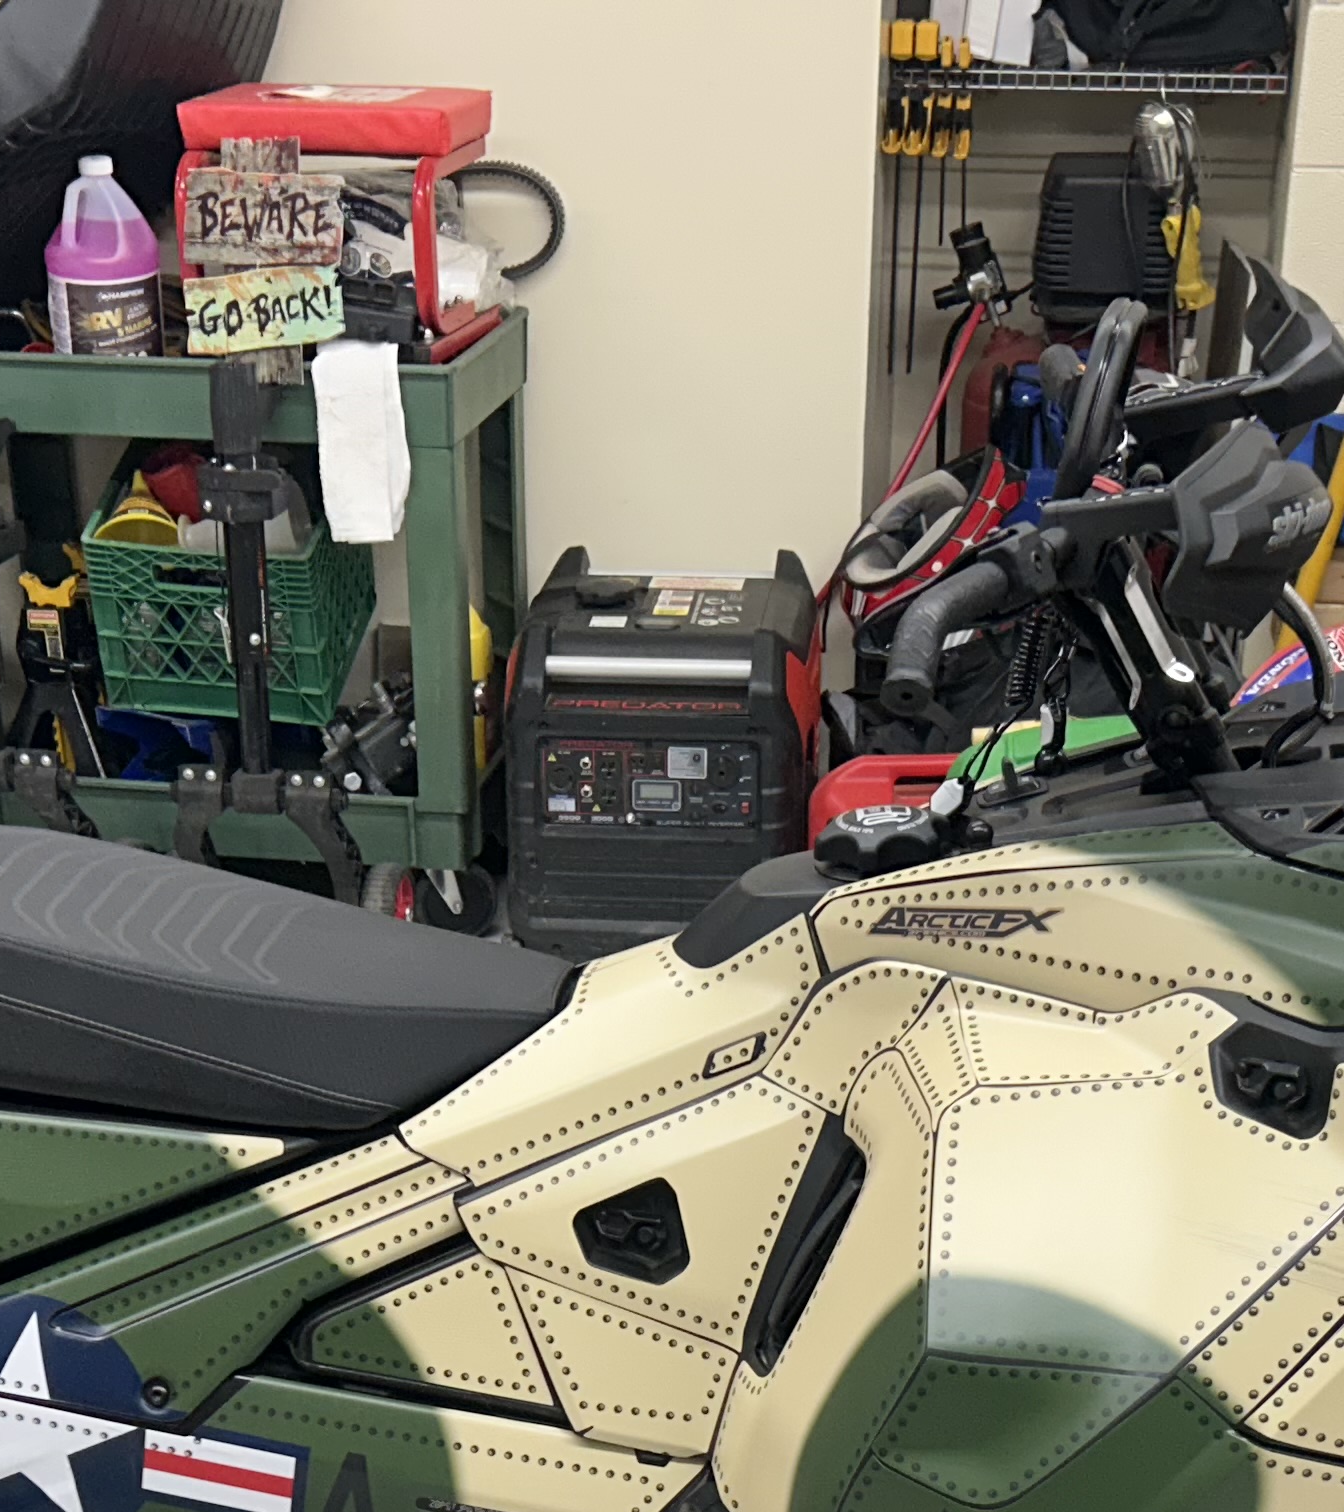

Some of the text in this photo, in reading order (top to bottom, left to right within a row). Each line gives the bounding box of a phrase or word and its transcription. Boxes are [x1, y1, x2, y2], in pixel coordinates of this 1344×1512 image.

[196, 191, 336, 243] BEWARE
[199, 297, 244, 337] GO
[253, 284, 333, 338] BACK!
[552, 699, 742, 711] PREDATOR
